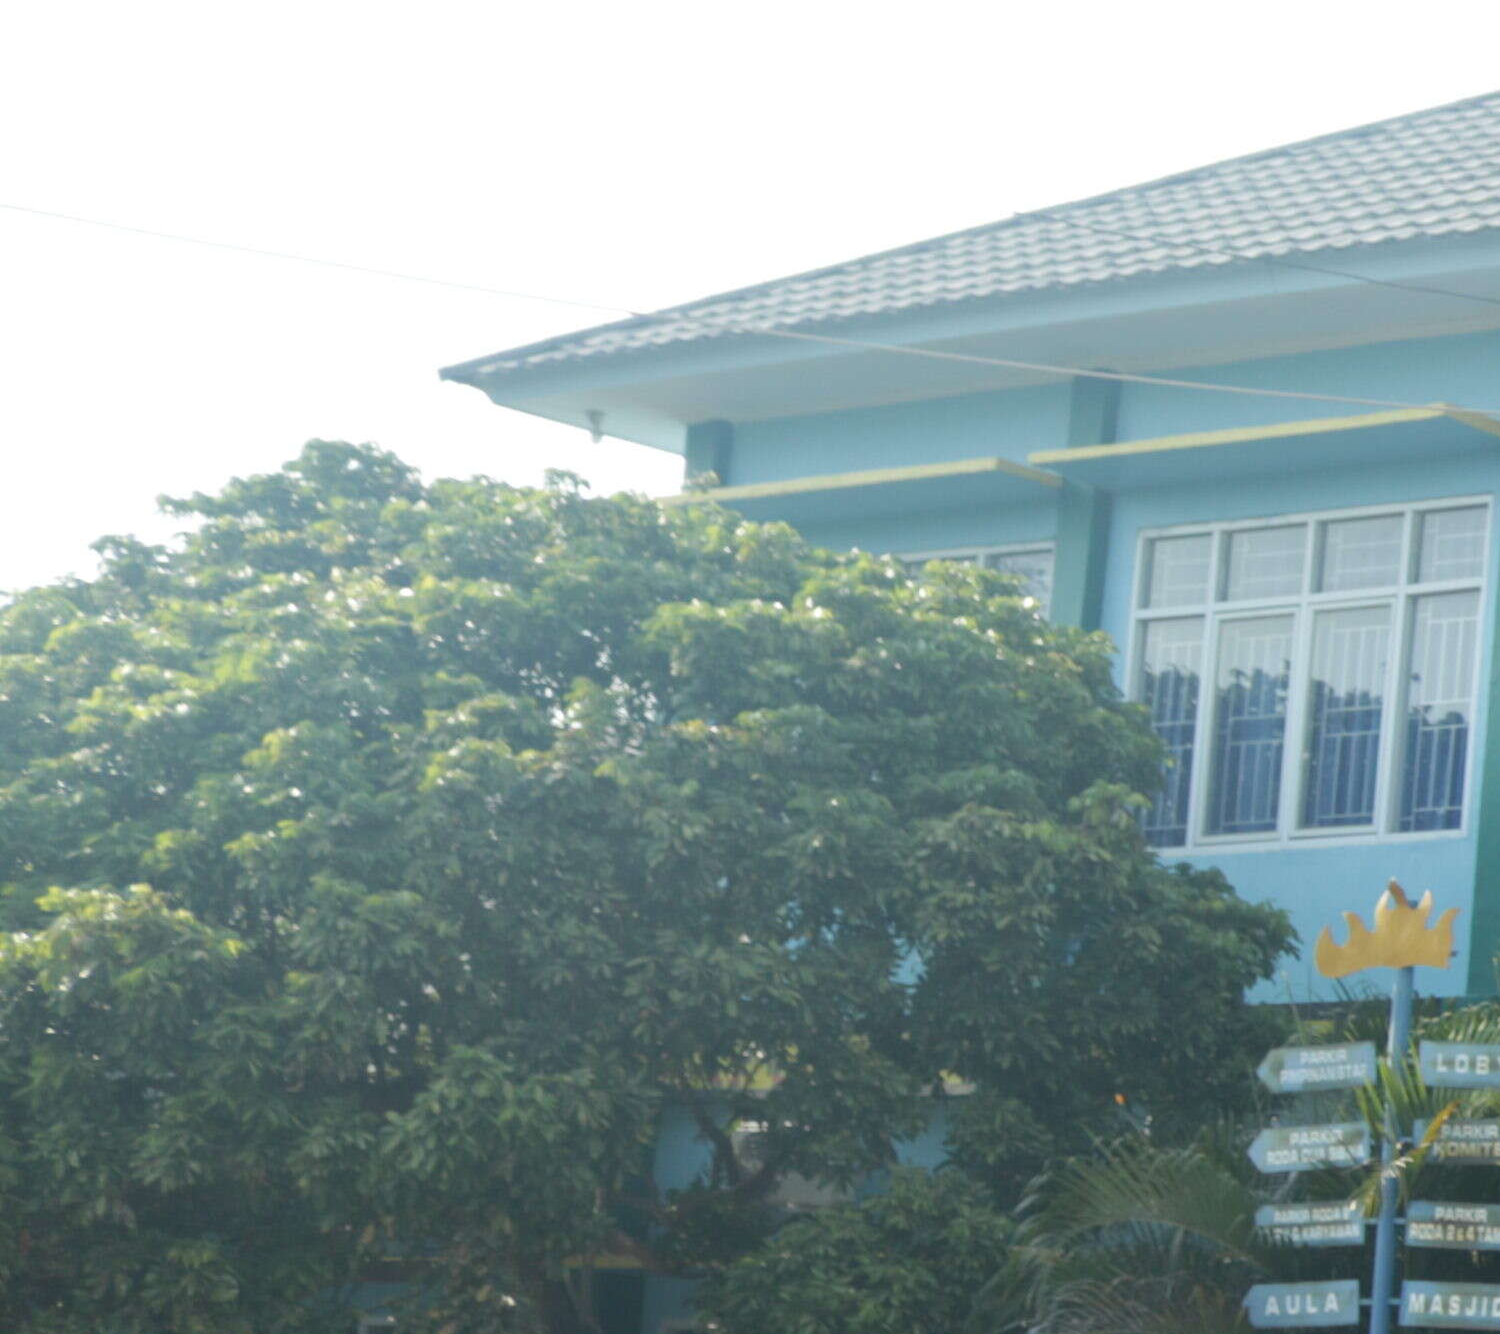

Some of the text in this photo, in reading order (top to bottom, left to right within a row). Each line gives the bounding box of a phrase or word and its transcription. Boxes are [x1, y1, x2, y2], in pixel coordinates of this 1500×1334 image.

[1441, 1124, 1499, 1139] PARKIR
[1434, 1206, 1488, 1222] PARKIR
[1265, 1292, 1340, 1316] AULA
